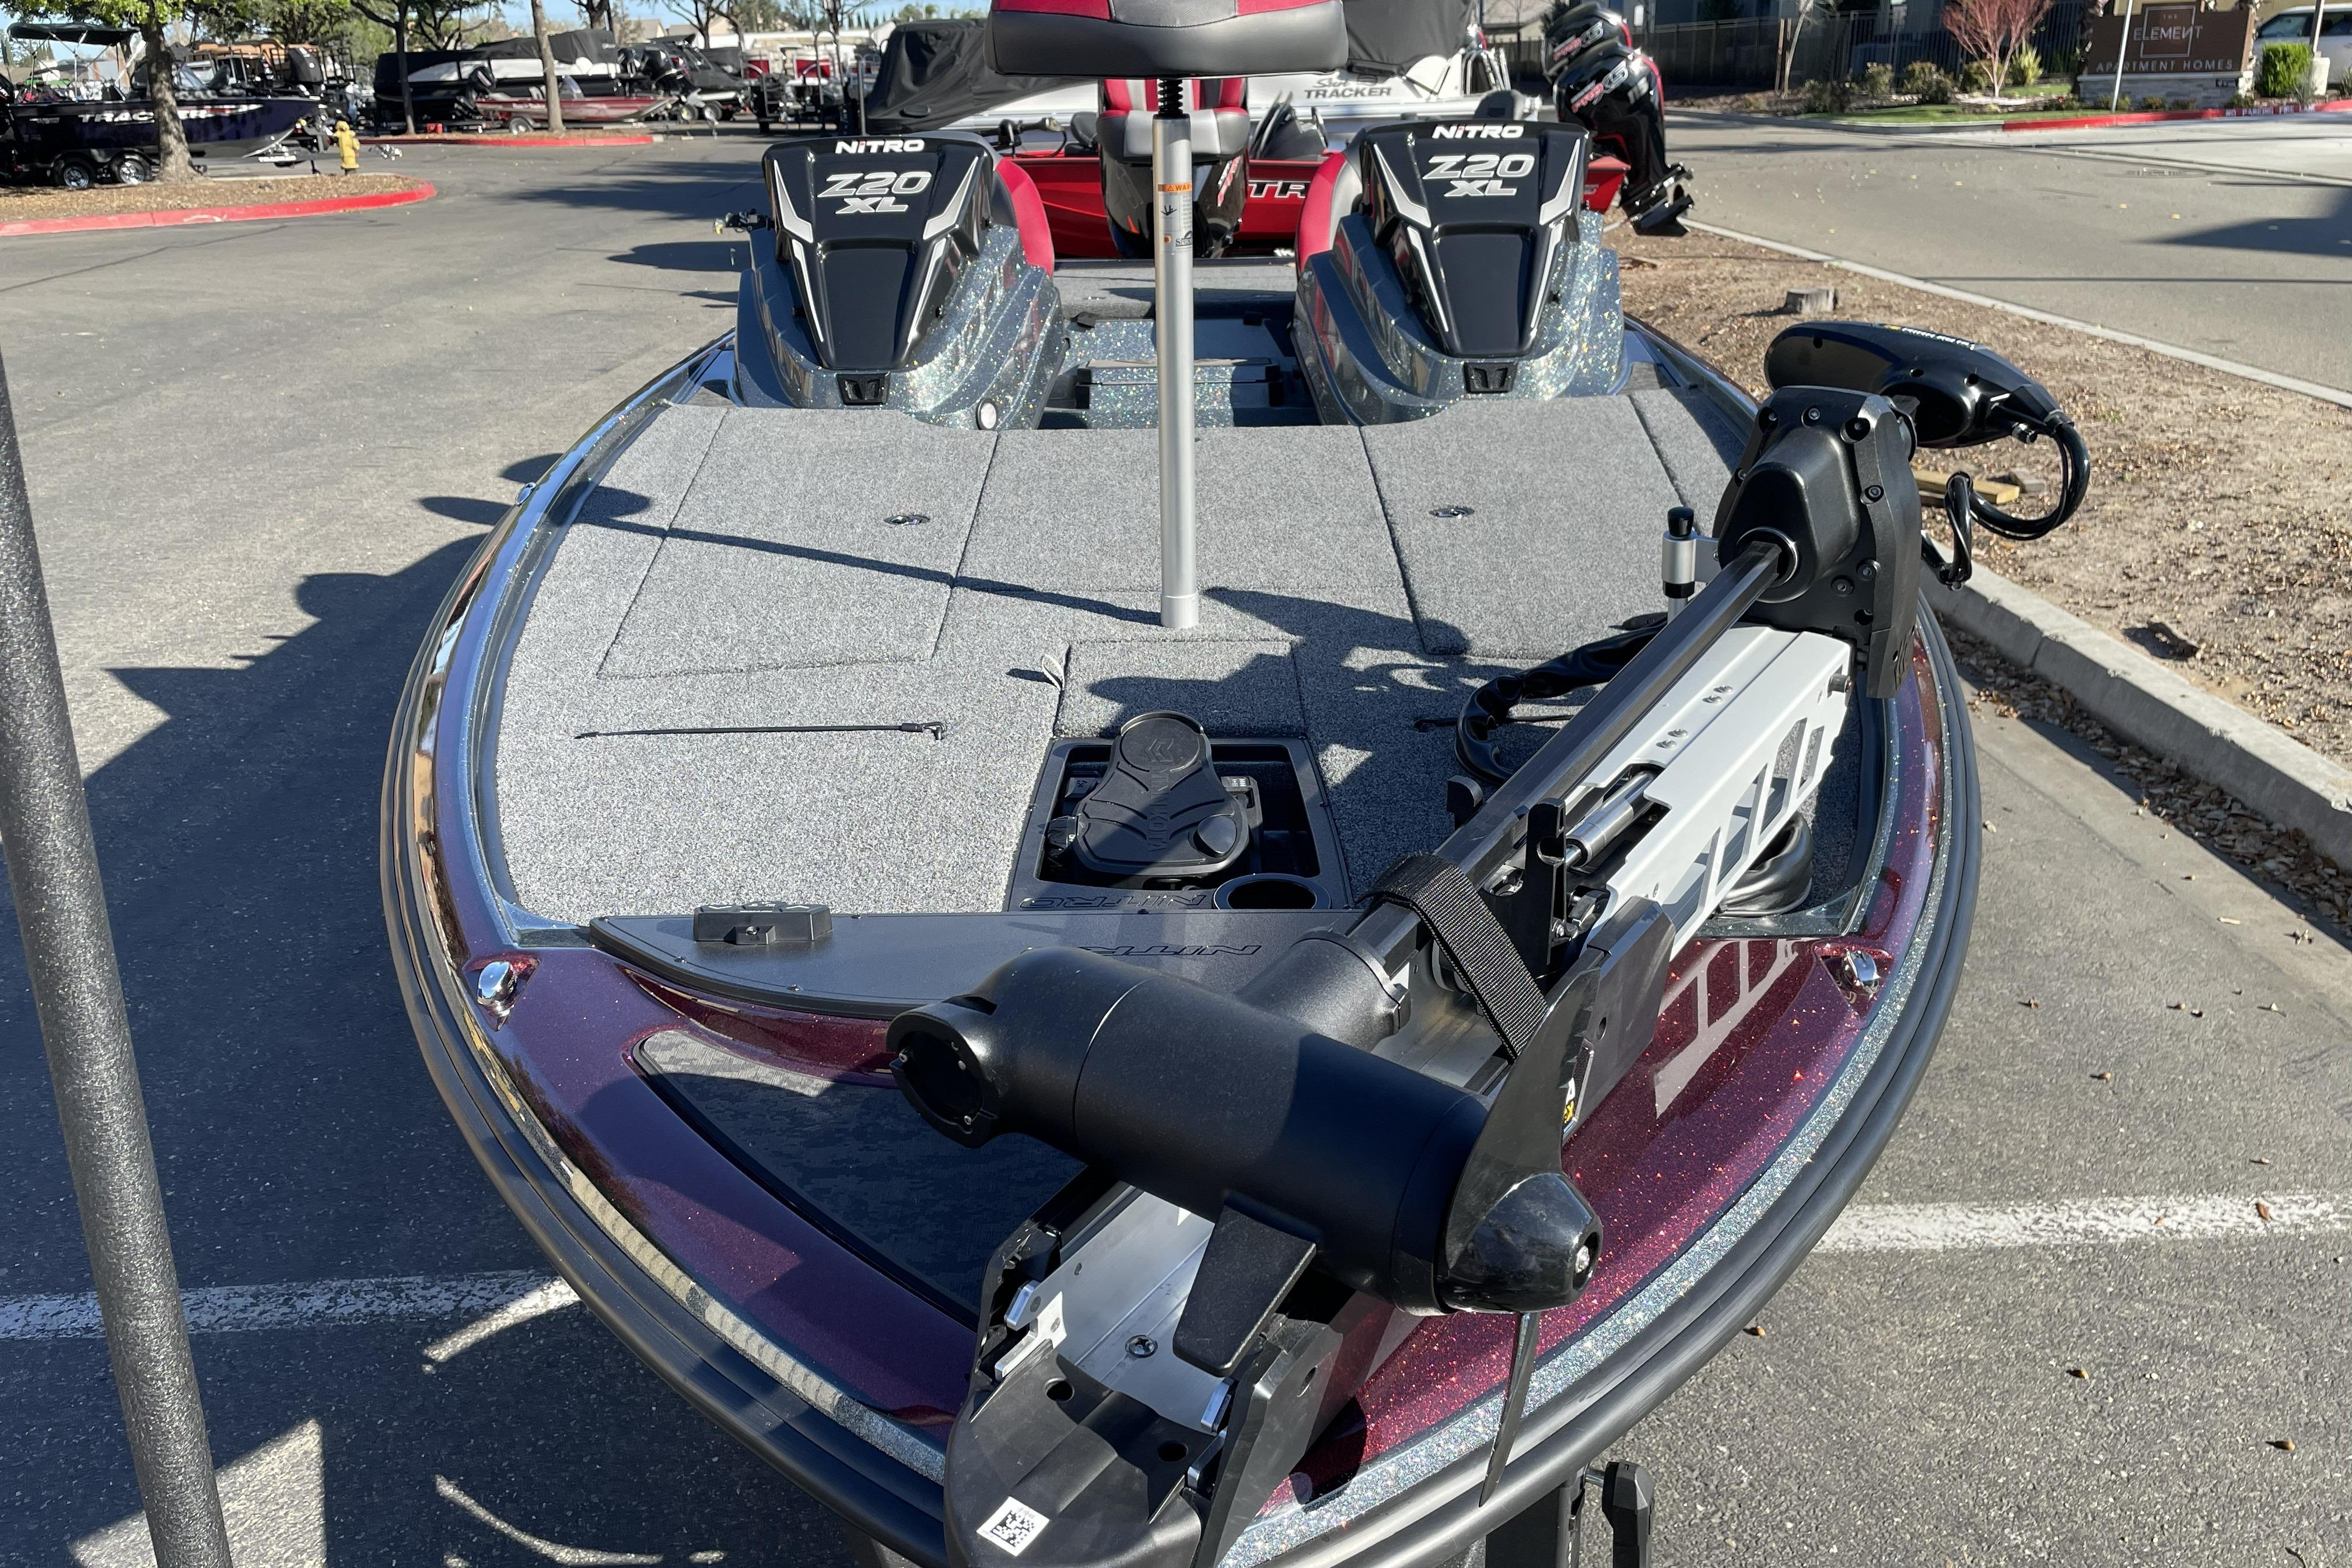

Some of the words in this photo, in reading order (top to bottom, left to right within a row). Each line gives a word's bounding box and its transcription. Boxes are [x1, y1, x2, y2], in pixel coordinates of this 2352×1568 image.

[2133, 26, 2203, 41] ELEMENT
[2183, 60, 2233, 71] HOMES
[1304, 88, 1391, 99] TRACKER
[78, 110, 206, 123] TRACER
[1432, 125, 1524, 138] NITRO
[835, 139, 925, 154] NITRO
[1422, 154, 1535, 179] Z20
[817, 172, 932, 198] Z20
[1443, 180, 1518, 197] XL
[835, 197, 909, 214] XL
